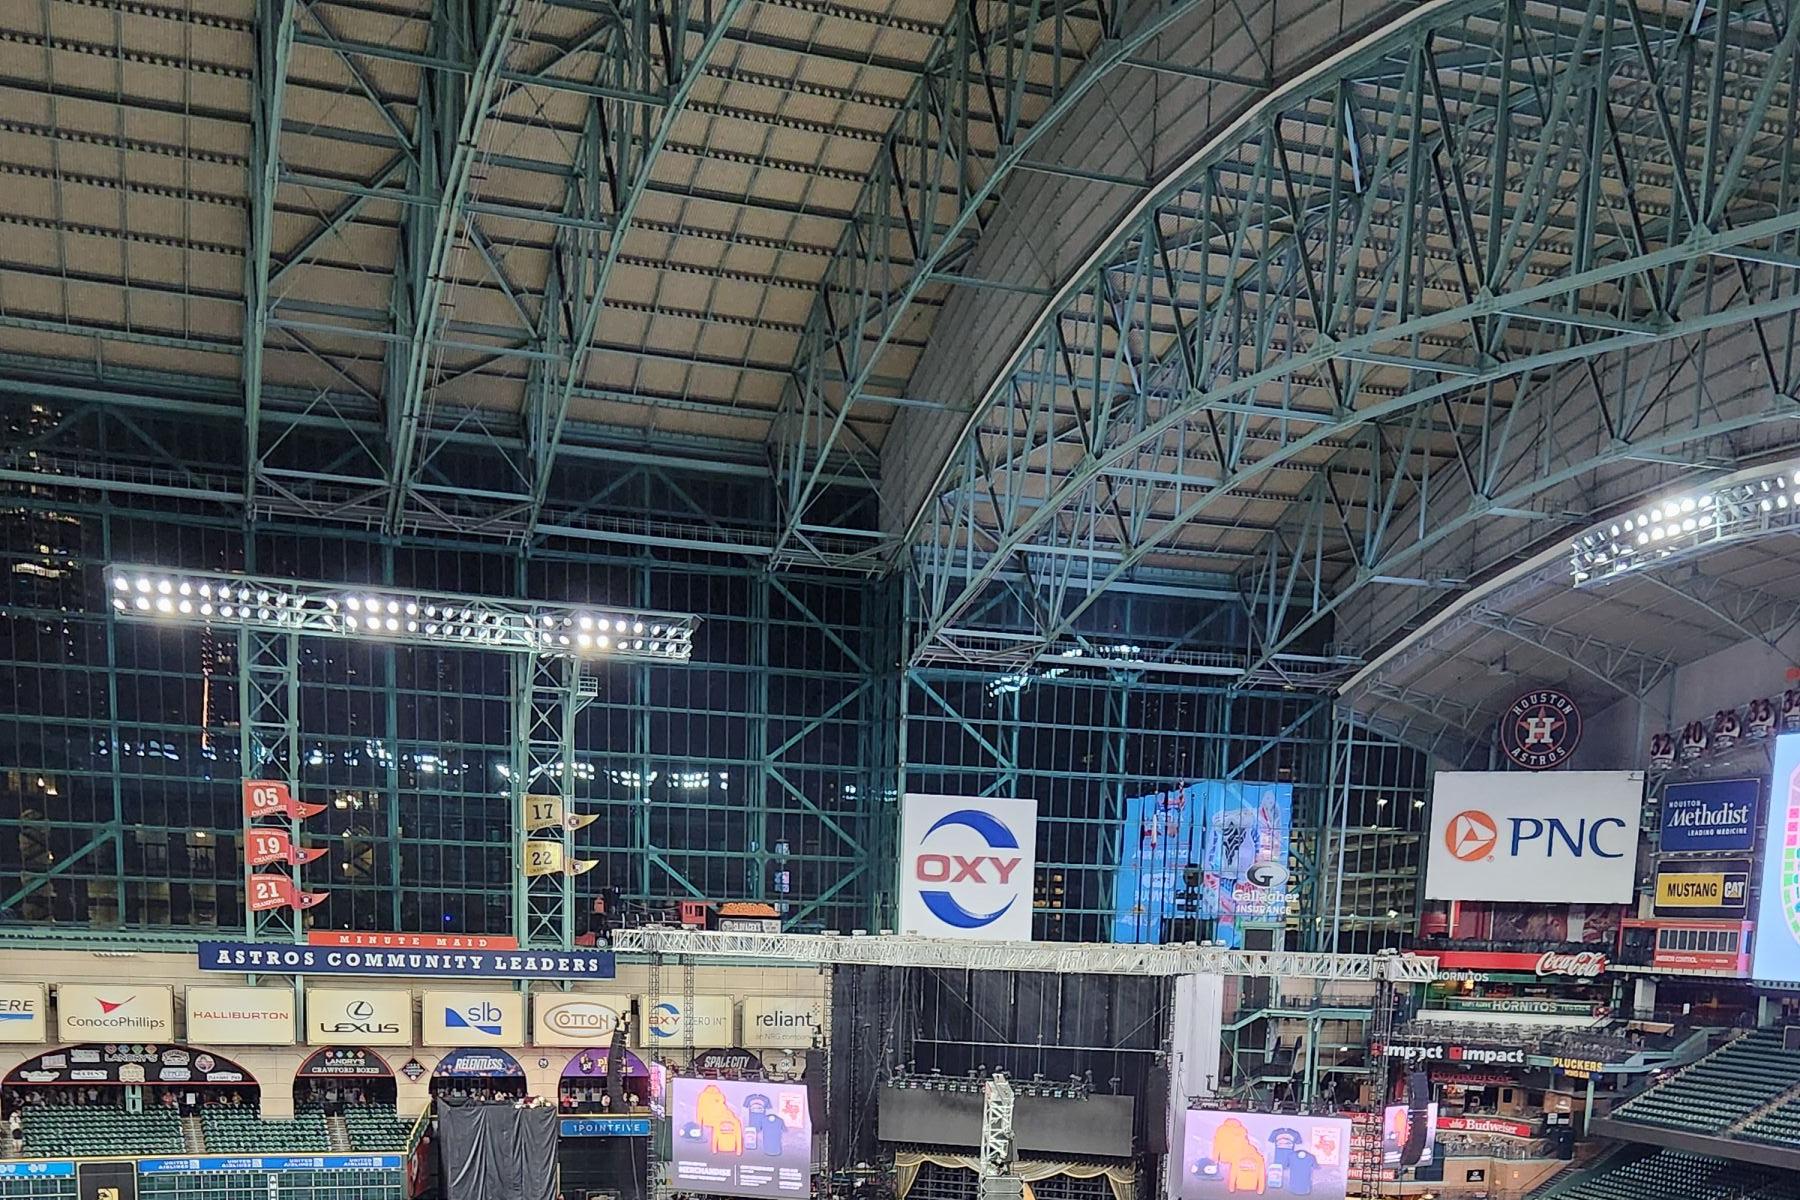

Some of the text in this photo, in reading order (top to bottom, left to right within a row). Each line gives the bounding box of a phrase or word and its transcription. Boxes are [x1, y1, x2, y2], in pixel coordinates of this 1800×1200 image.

[1512, 693, 1573, 715] HOUSTON
[1525, 717, 1555, 743] H
[1651, 733, 1672, 756] 32
[1511, 747, 1566, 765] ASTROS
[253, 788, 278, 807] 05
[1669, 800, 1701, 808] HOUSTON
[533, 803, 553, 819] 17
[1667, 802, 1749, 828] Methodist
[1507, 816, 1626, 858] PNC
[1716, 827, 1748, 836] MEDICINE
[256, 837, 280, 854] 19
[532, 852, 552, 865] 22
[916, 853, 1022, 885] OXY
[256, 881, 279, 899] 21
[1232, 889, 1299, 903] Gallagher
[1667, 882, 1745, 898] MUSTANG CAT
[1236, 905, 1292, 914] INSURANCE
[338, 935, 490, 949] MINUTE MAID
[217, 950, 600, 972] ASTROS COMMUNITY LEADERS
[1437, 972, 1489, 982] HORNITOS
[468, 1002, 502, 1022] slb
[1493, 1001, 1557, 1012] HORNITOS
[67, 1016, 165, 1030] ConocoPhillips
[193, 1011, 289, 1020] HALLIBURTON
[554, 1010, 609, 1029] COTTON
[756, 1010, 812, 1026] reliant
[320, 1023, 399, 1034] LEXUS
[104, 1053, 158, 1062] LANDRY'S
[731, 1056, 750, 1069] CITY
[1463, 1046, 1524, 1064] impact
[455, 1058, 504, 1070] RELENTLESS
[1553, 1056, 1603, 1072] PLUCKERS
[573, 1123, 641, 1132] 1POINTFIVE
[1466, 1119, 1518, 1135] Budweiser
